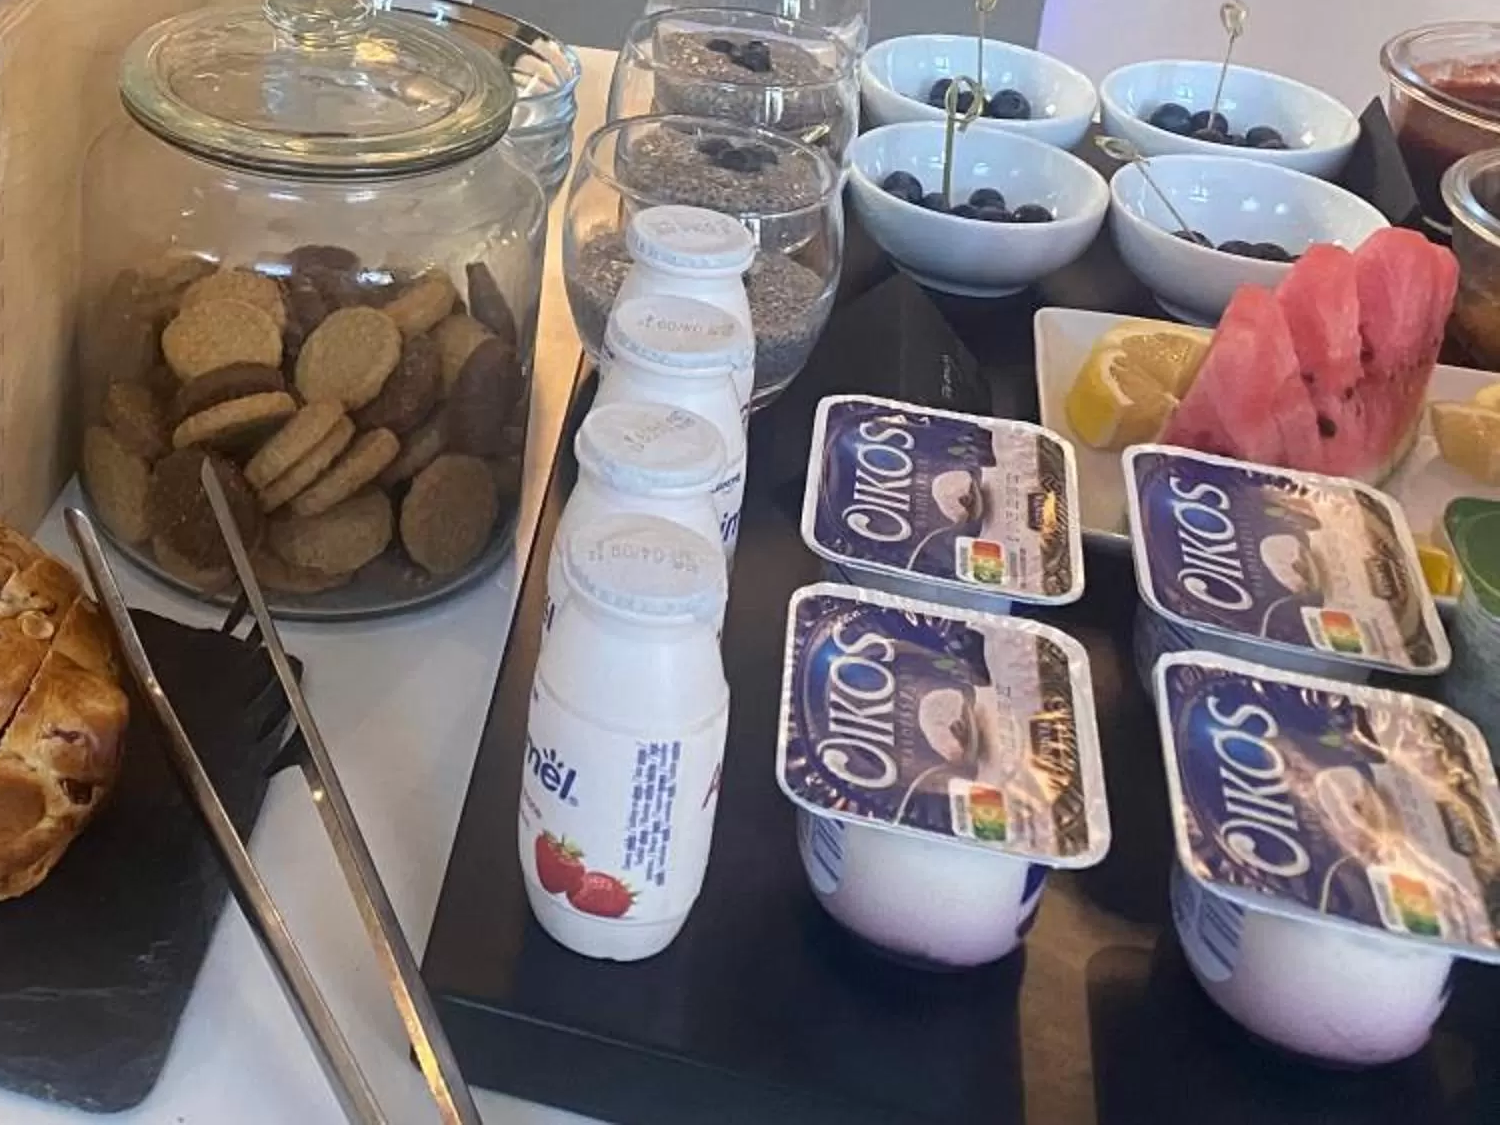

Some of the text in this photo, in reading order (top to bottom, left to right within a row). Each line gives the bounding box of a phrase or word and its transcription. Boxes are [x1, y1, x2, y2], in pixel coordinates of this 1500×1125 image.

[841, 420, 916, 543] OIKOS
[1169, 475, 1254, 612] OIKOS
[815, 620, 898, 790] OIKOS
[1206, 694, 1311, 878] OIKOS
